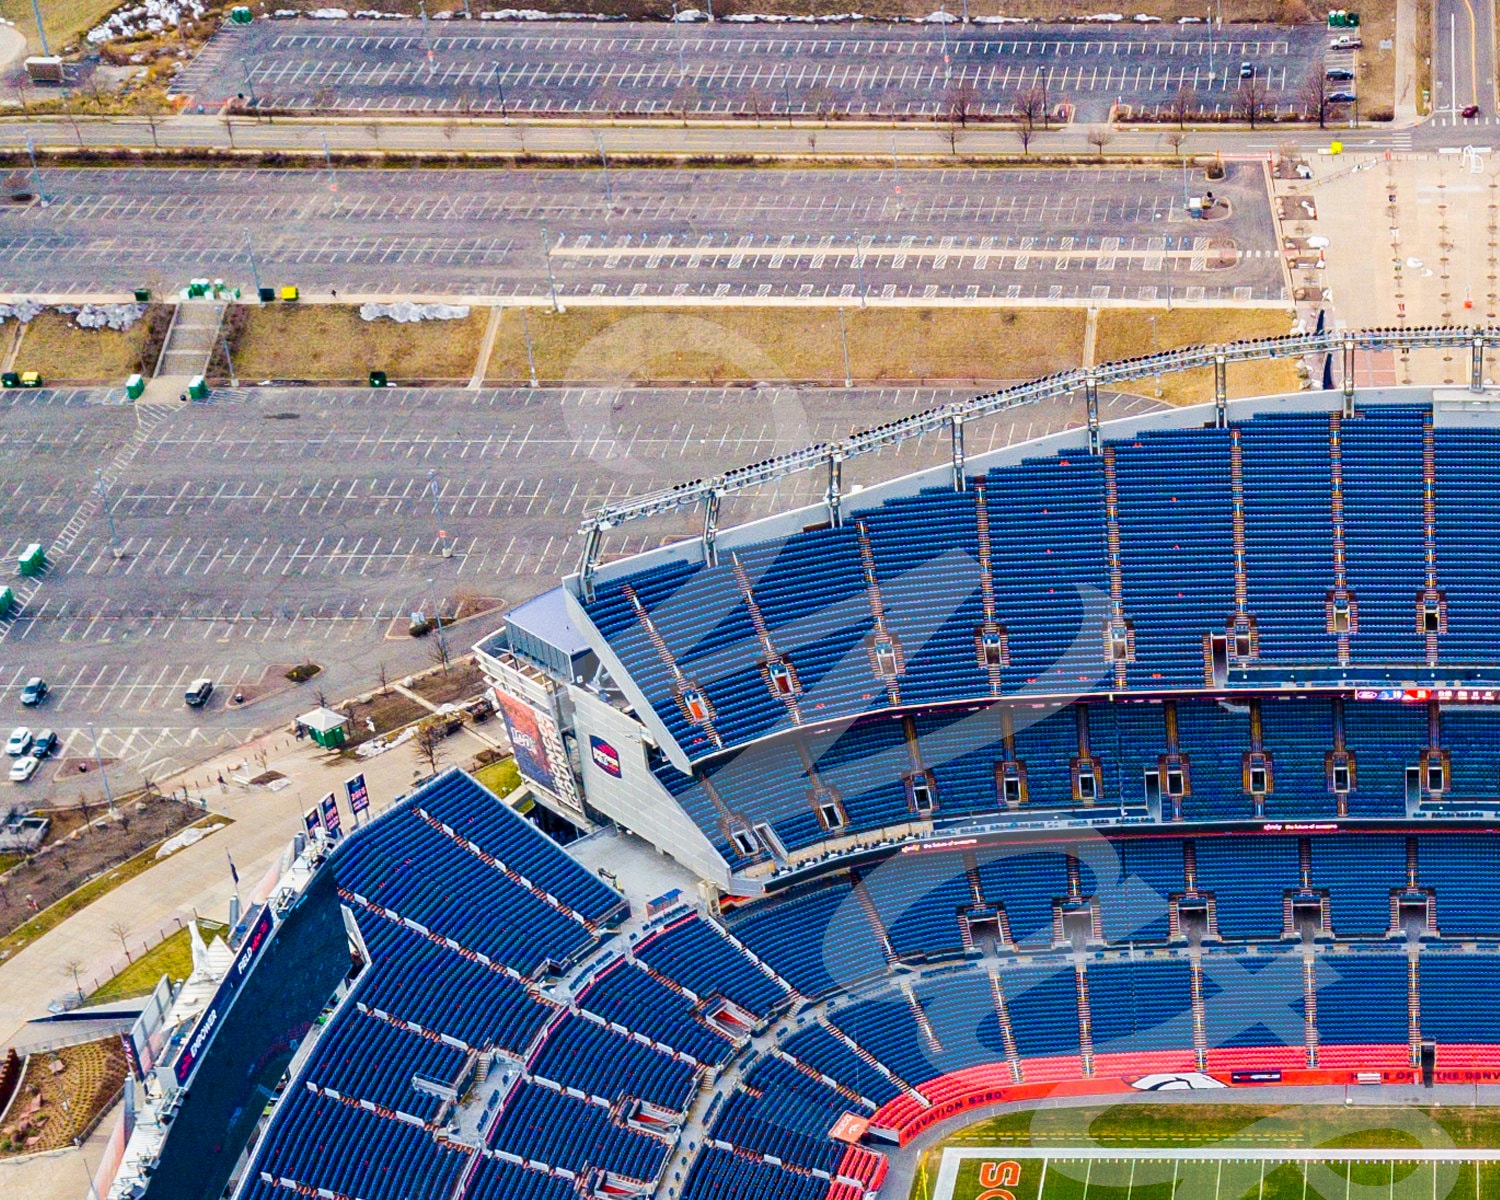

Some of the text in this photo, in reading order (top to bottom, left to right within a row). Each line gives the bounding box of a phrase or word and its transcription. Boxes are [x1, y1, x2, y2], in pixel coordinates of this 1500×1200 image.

[237, 945, 254, 975] FIELD
[189, 1008, 219, 1058] EMPOWER
[905, 1100, 964, 1139] ELEVATION
